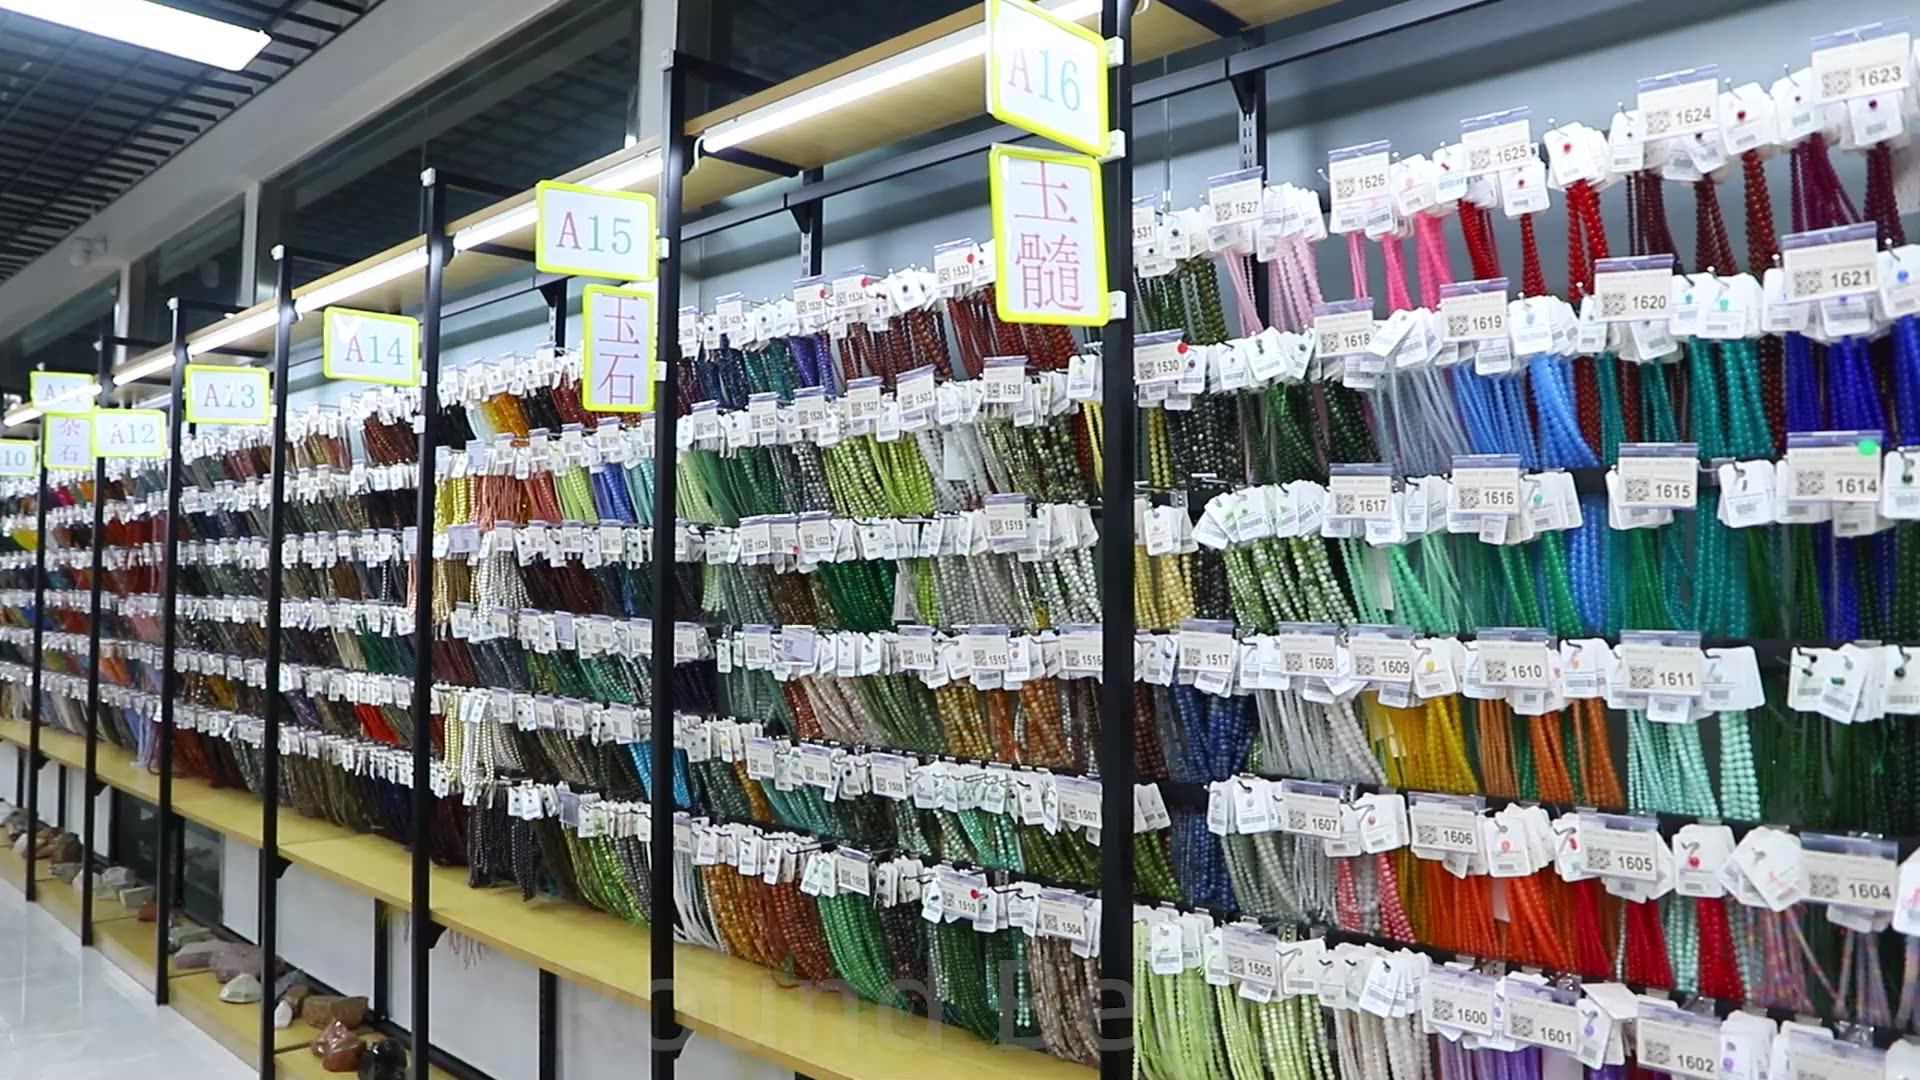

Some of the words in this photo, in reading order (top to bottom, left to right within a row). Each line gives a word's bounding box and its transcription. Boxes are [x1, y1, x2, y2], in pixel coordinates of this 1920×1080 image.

[1008, 48, 1081, 112] A16
[1859, 66, 1902, 87] 1623
[1676, 107, 1712, 125] 1624
[1497, 144, 1527, 163] 1625
[1358, 174, 1386, 190] 1626
[1235, 201, 1259, 216] 1627
[556, 212, 632, 255] A15
[1014, 160, 1084, 311] 玉髓
[1133, 226, 1153, 240] 531
[1831, 270, 1872, 288] 1621
[1632, 295, 1667, 310] 1620
[1473, 315, 1502, 330] 1619
[597, 293, 640, 405] 玉石
[1344, 334, 1370, 348] 1618
[345, 336, 404, 366] A14
[1157, 360, 1179, 374] 1530
[202, 383, 256, 408] A13
[110, 424, 156, 444] A12
[3, 450, 26, 466] 10
[1655, 485, 1691, 499] 1615
[1837, 478, 1878, 494] 1614
[1359, 499, 1386, 512] 1617
[1484, 491, 1514, 505] 1616
[1206, 654, 1229, 666] 1517
[1309, 657, 1335, 670] 1608
[1381, 660, 1410, 674] 1609
[1511, 665, 1542, 678] 1610
[1659, 672, 1695, 687] 1611
[1311, 818, 1338, 832] 1607
[1444, 830, 1474, 845] 1606
[1618, 856, 1653, 871] 1605
[1849, 883, 1892, 900] 1604
[1062, 922, 1081, 934] 1504
[1248, 961, 1273, 977] 1505
[1457, 1009, 1488, 1025] 1600
[1540, 1026, 1573, 1044] 1601
[1677, 1054, 1715, 1073] 1602
